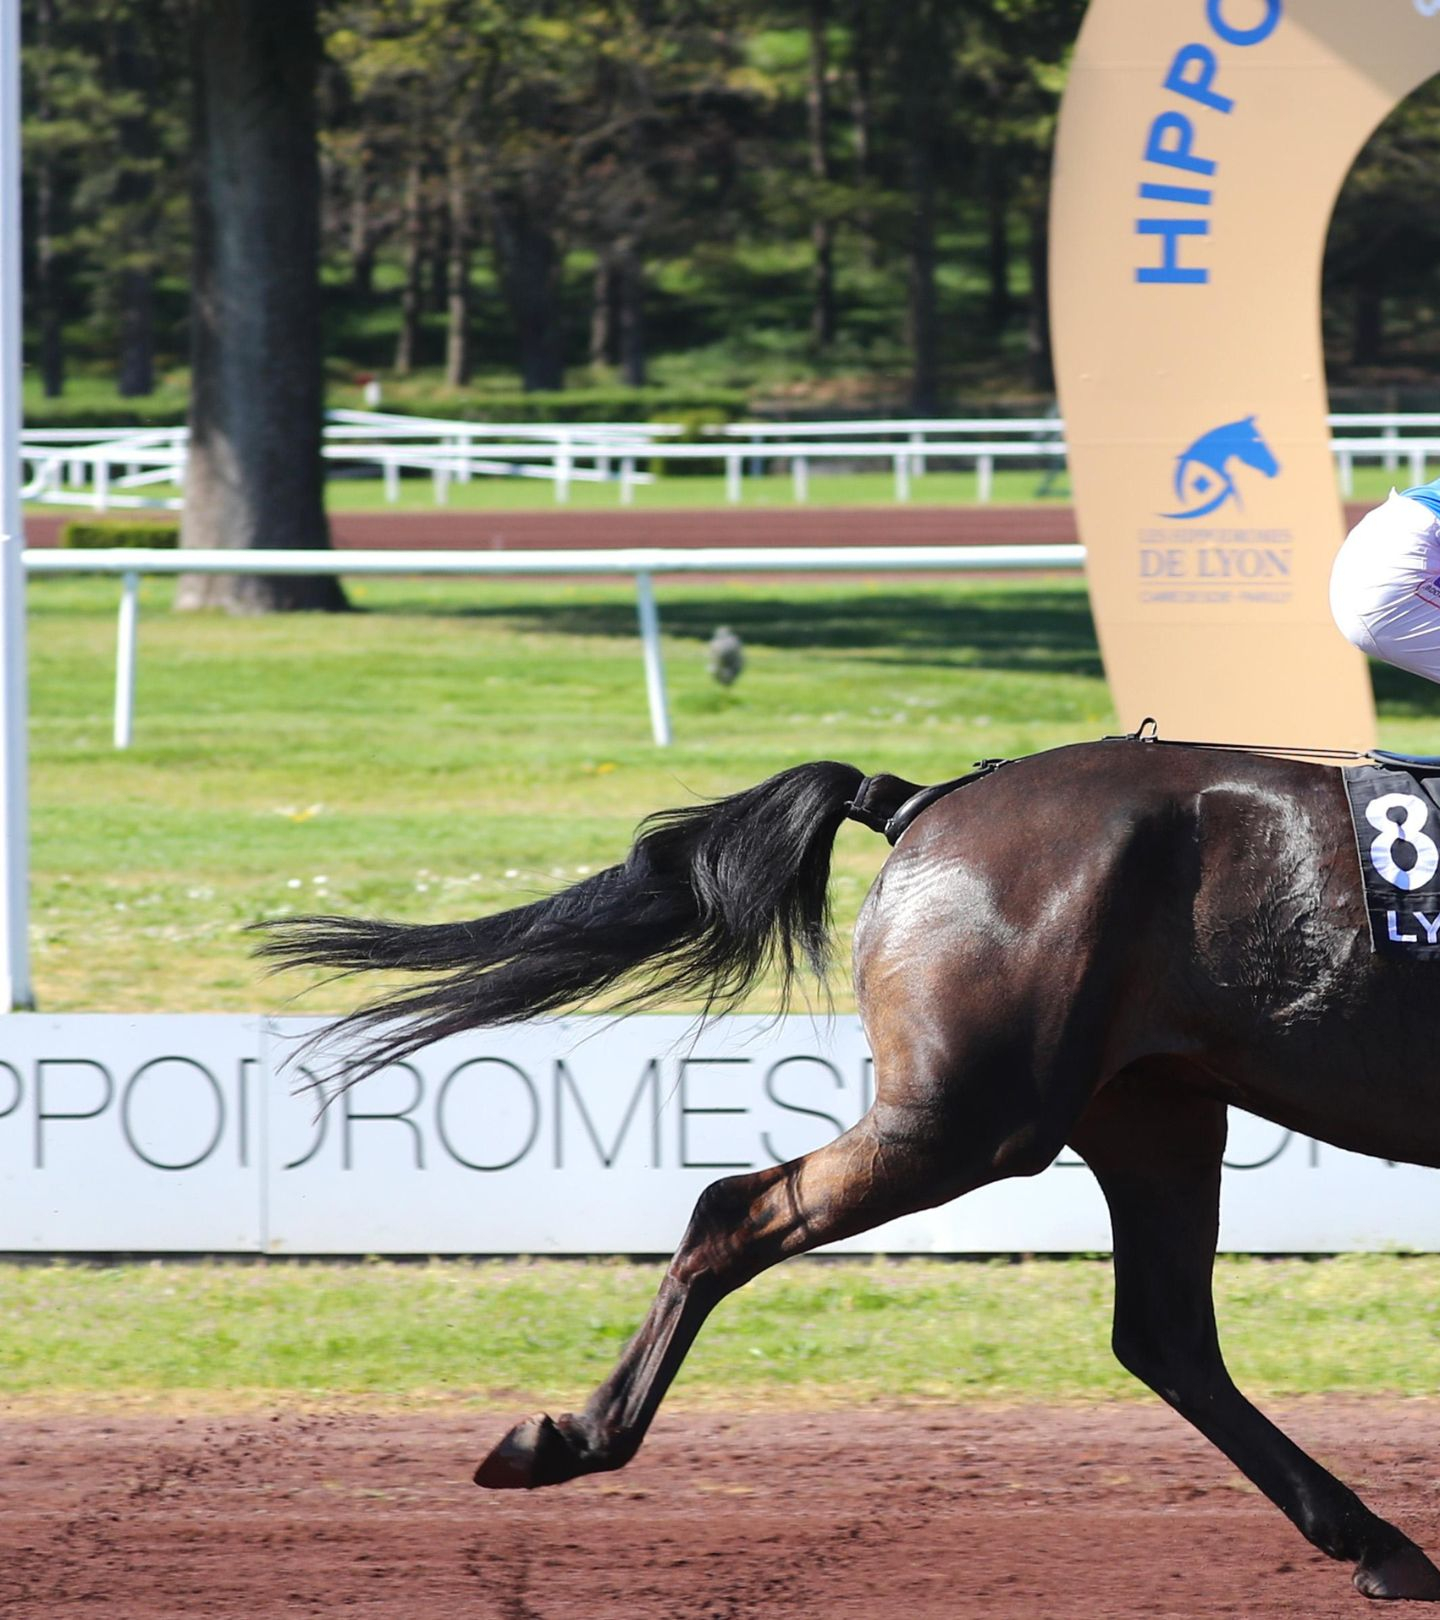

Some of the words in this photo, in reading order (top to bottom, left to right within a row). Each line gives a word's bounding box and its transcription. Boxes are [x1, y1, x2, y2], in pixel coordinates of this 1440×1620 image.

[1138, 549, 1186, 577] DE
[1196, 549, 1293, 577] LYON
[1365, 793, 1439, 890] 8
